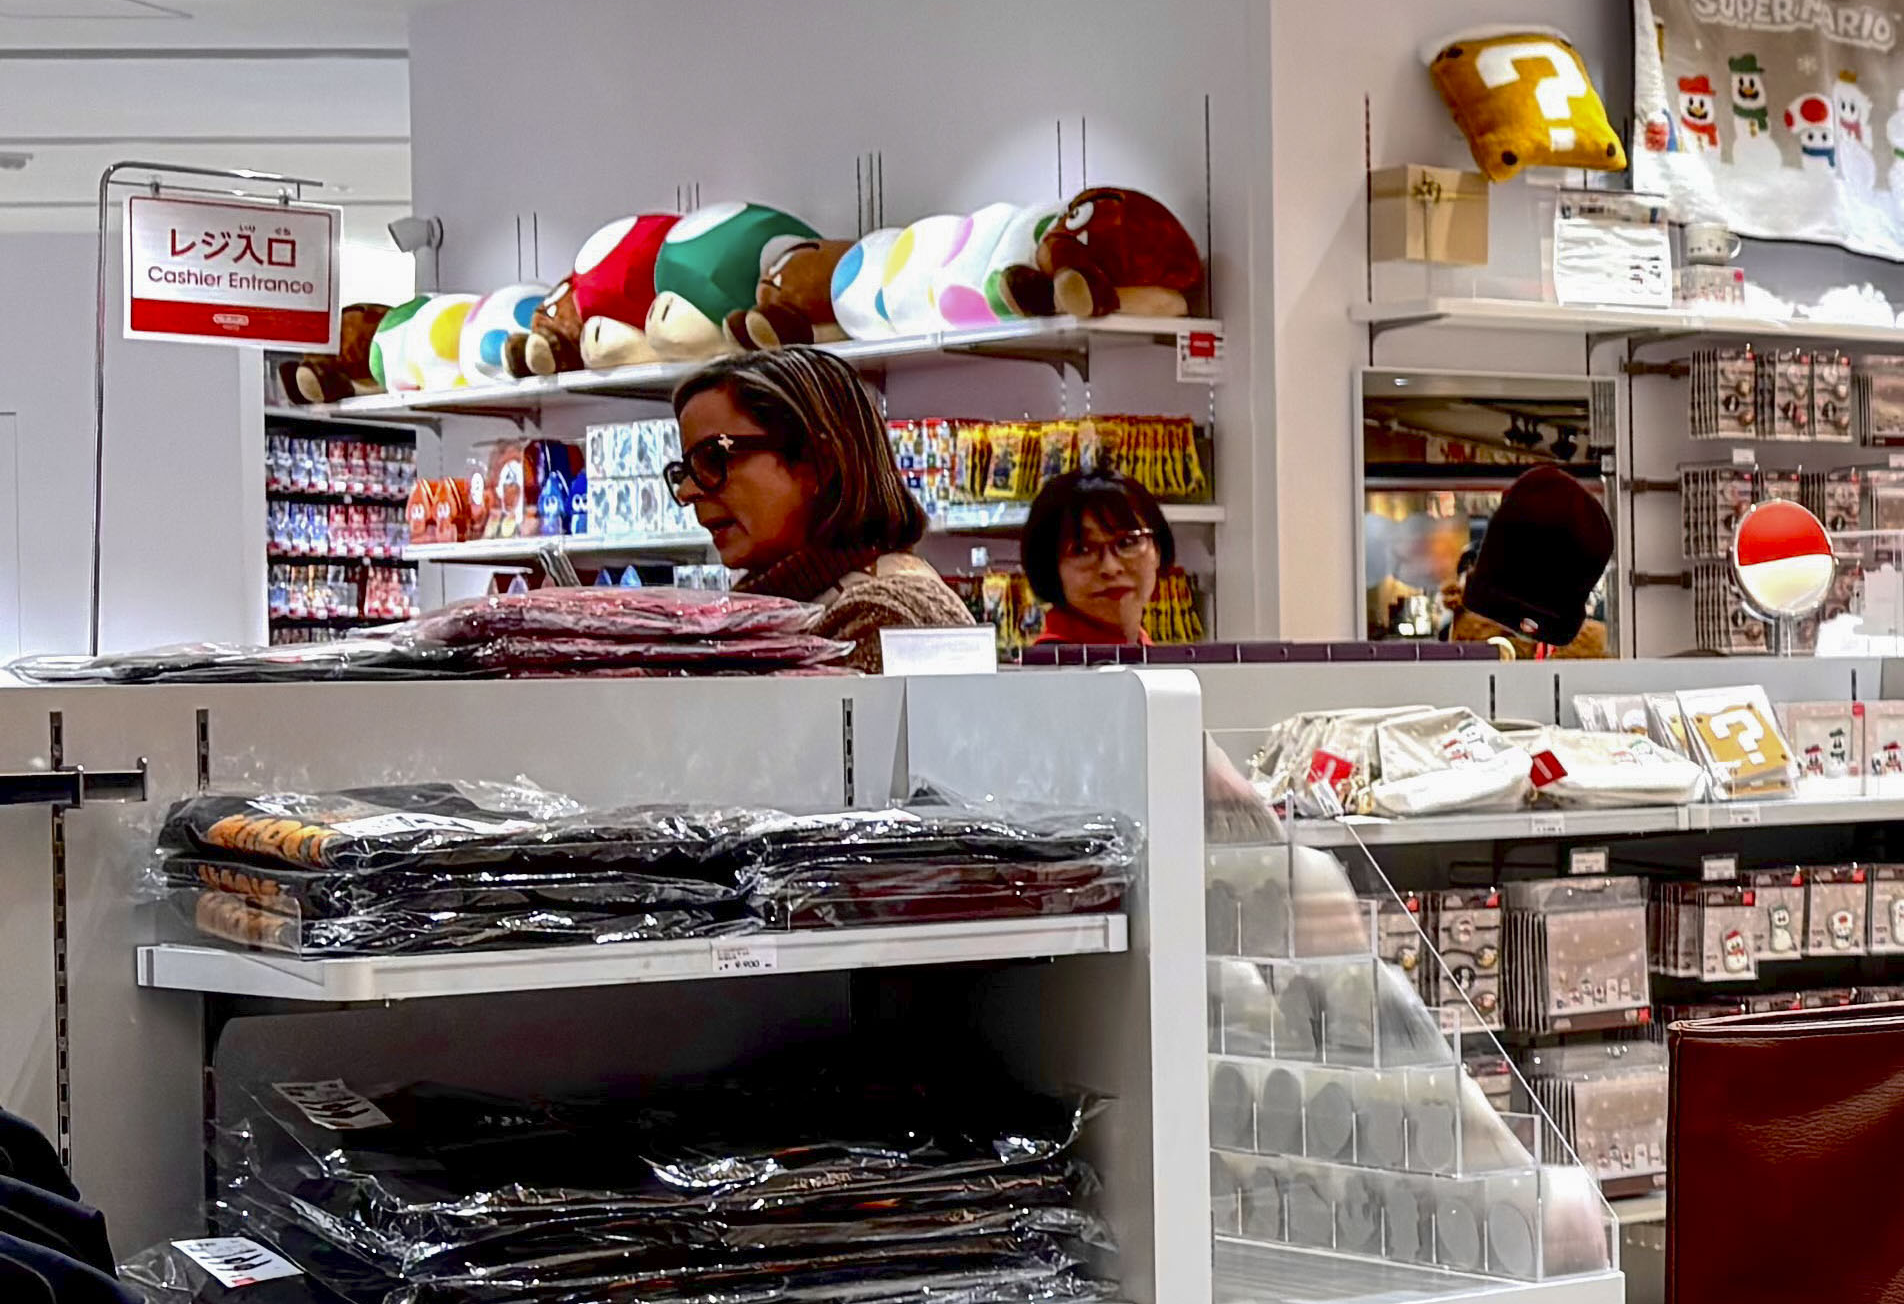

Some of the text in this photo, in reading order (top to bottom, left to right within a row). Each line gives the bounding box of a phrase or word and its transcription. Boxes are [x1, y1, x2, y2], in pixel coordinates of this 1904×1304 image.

[170, 228, 297, 268] レジ入口
[147, 265, 314, 295] Cashier Entrance
